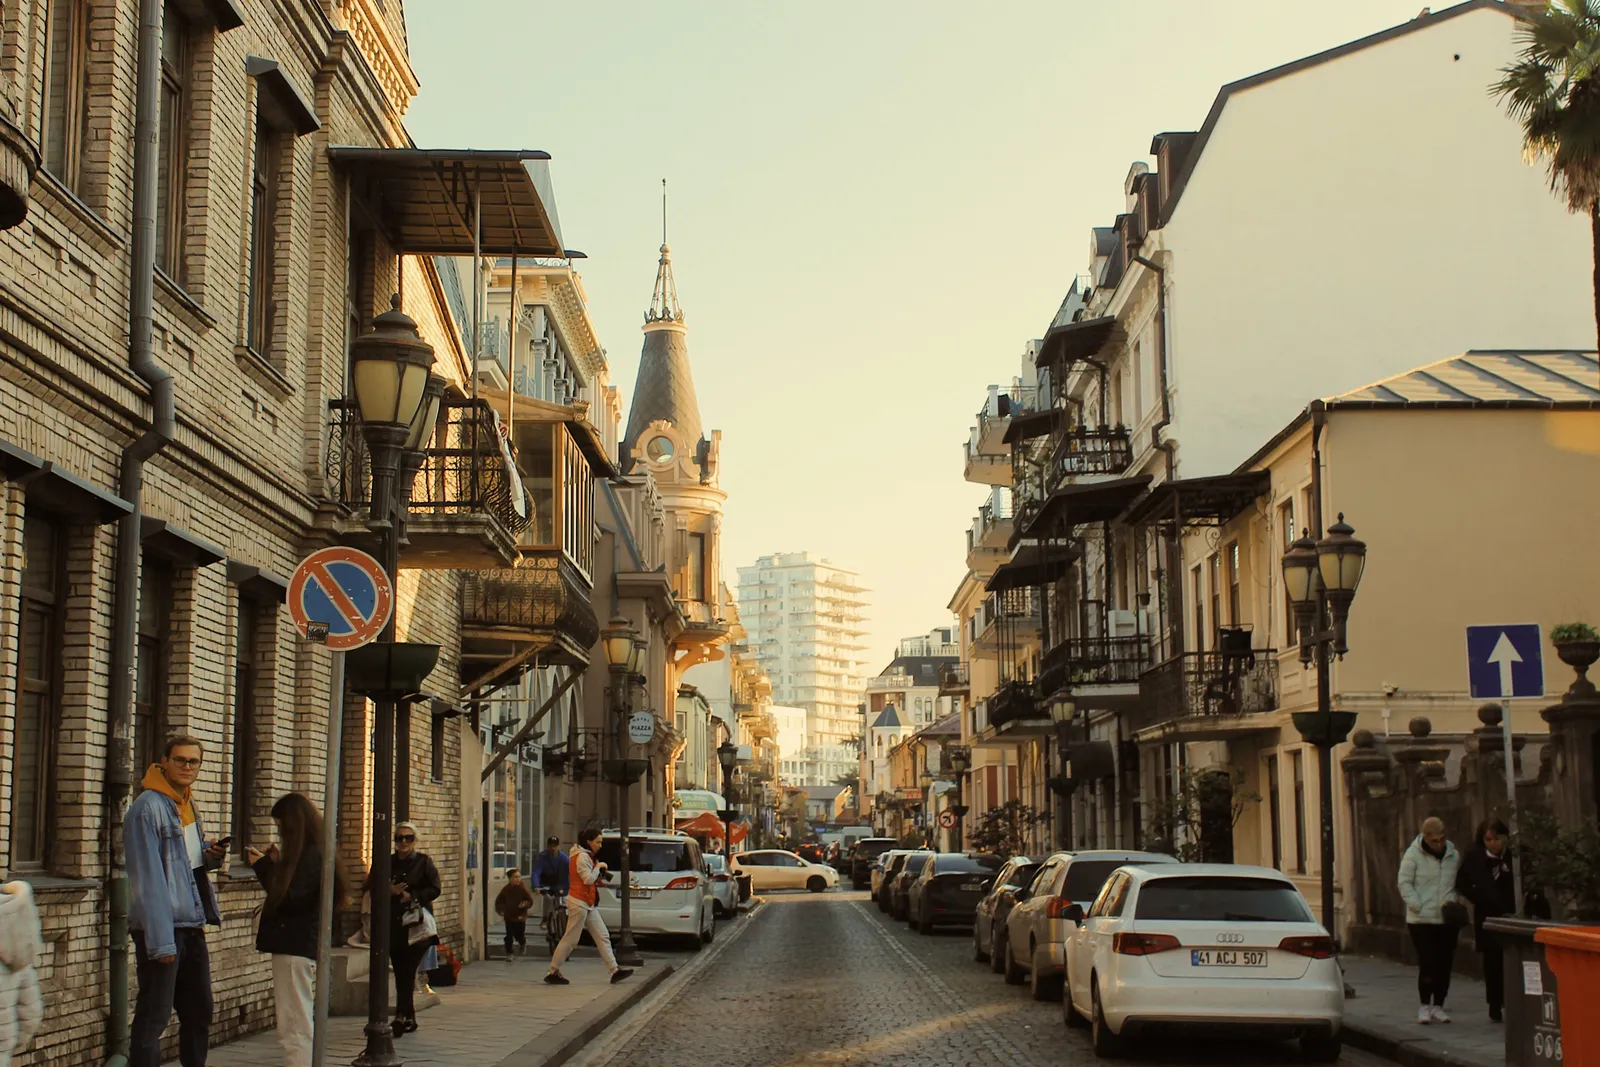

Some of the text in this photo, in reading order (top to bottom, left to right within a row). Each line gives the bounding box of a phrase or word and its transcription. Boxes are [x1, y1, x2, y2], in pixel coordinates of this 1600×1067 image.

[1198, 951, 1264, 965] 41 ACJ 507
